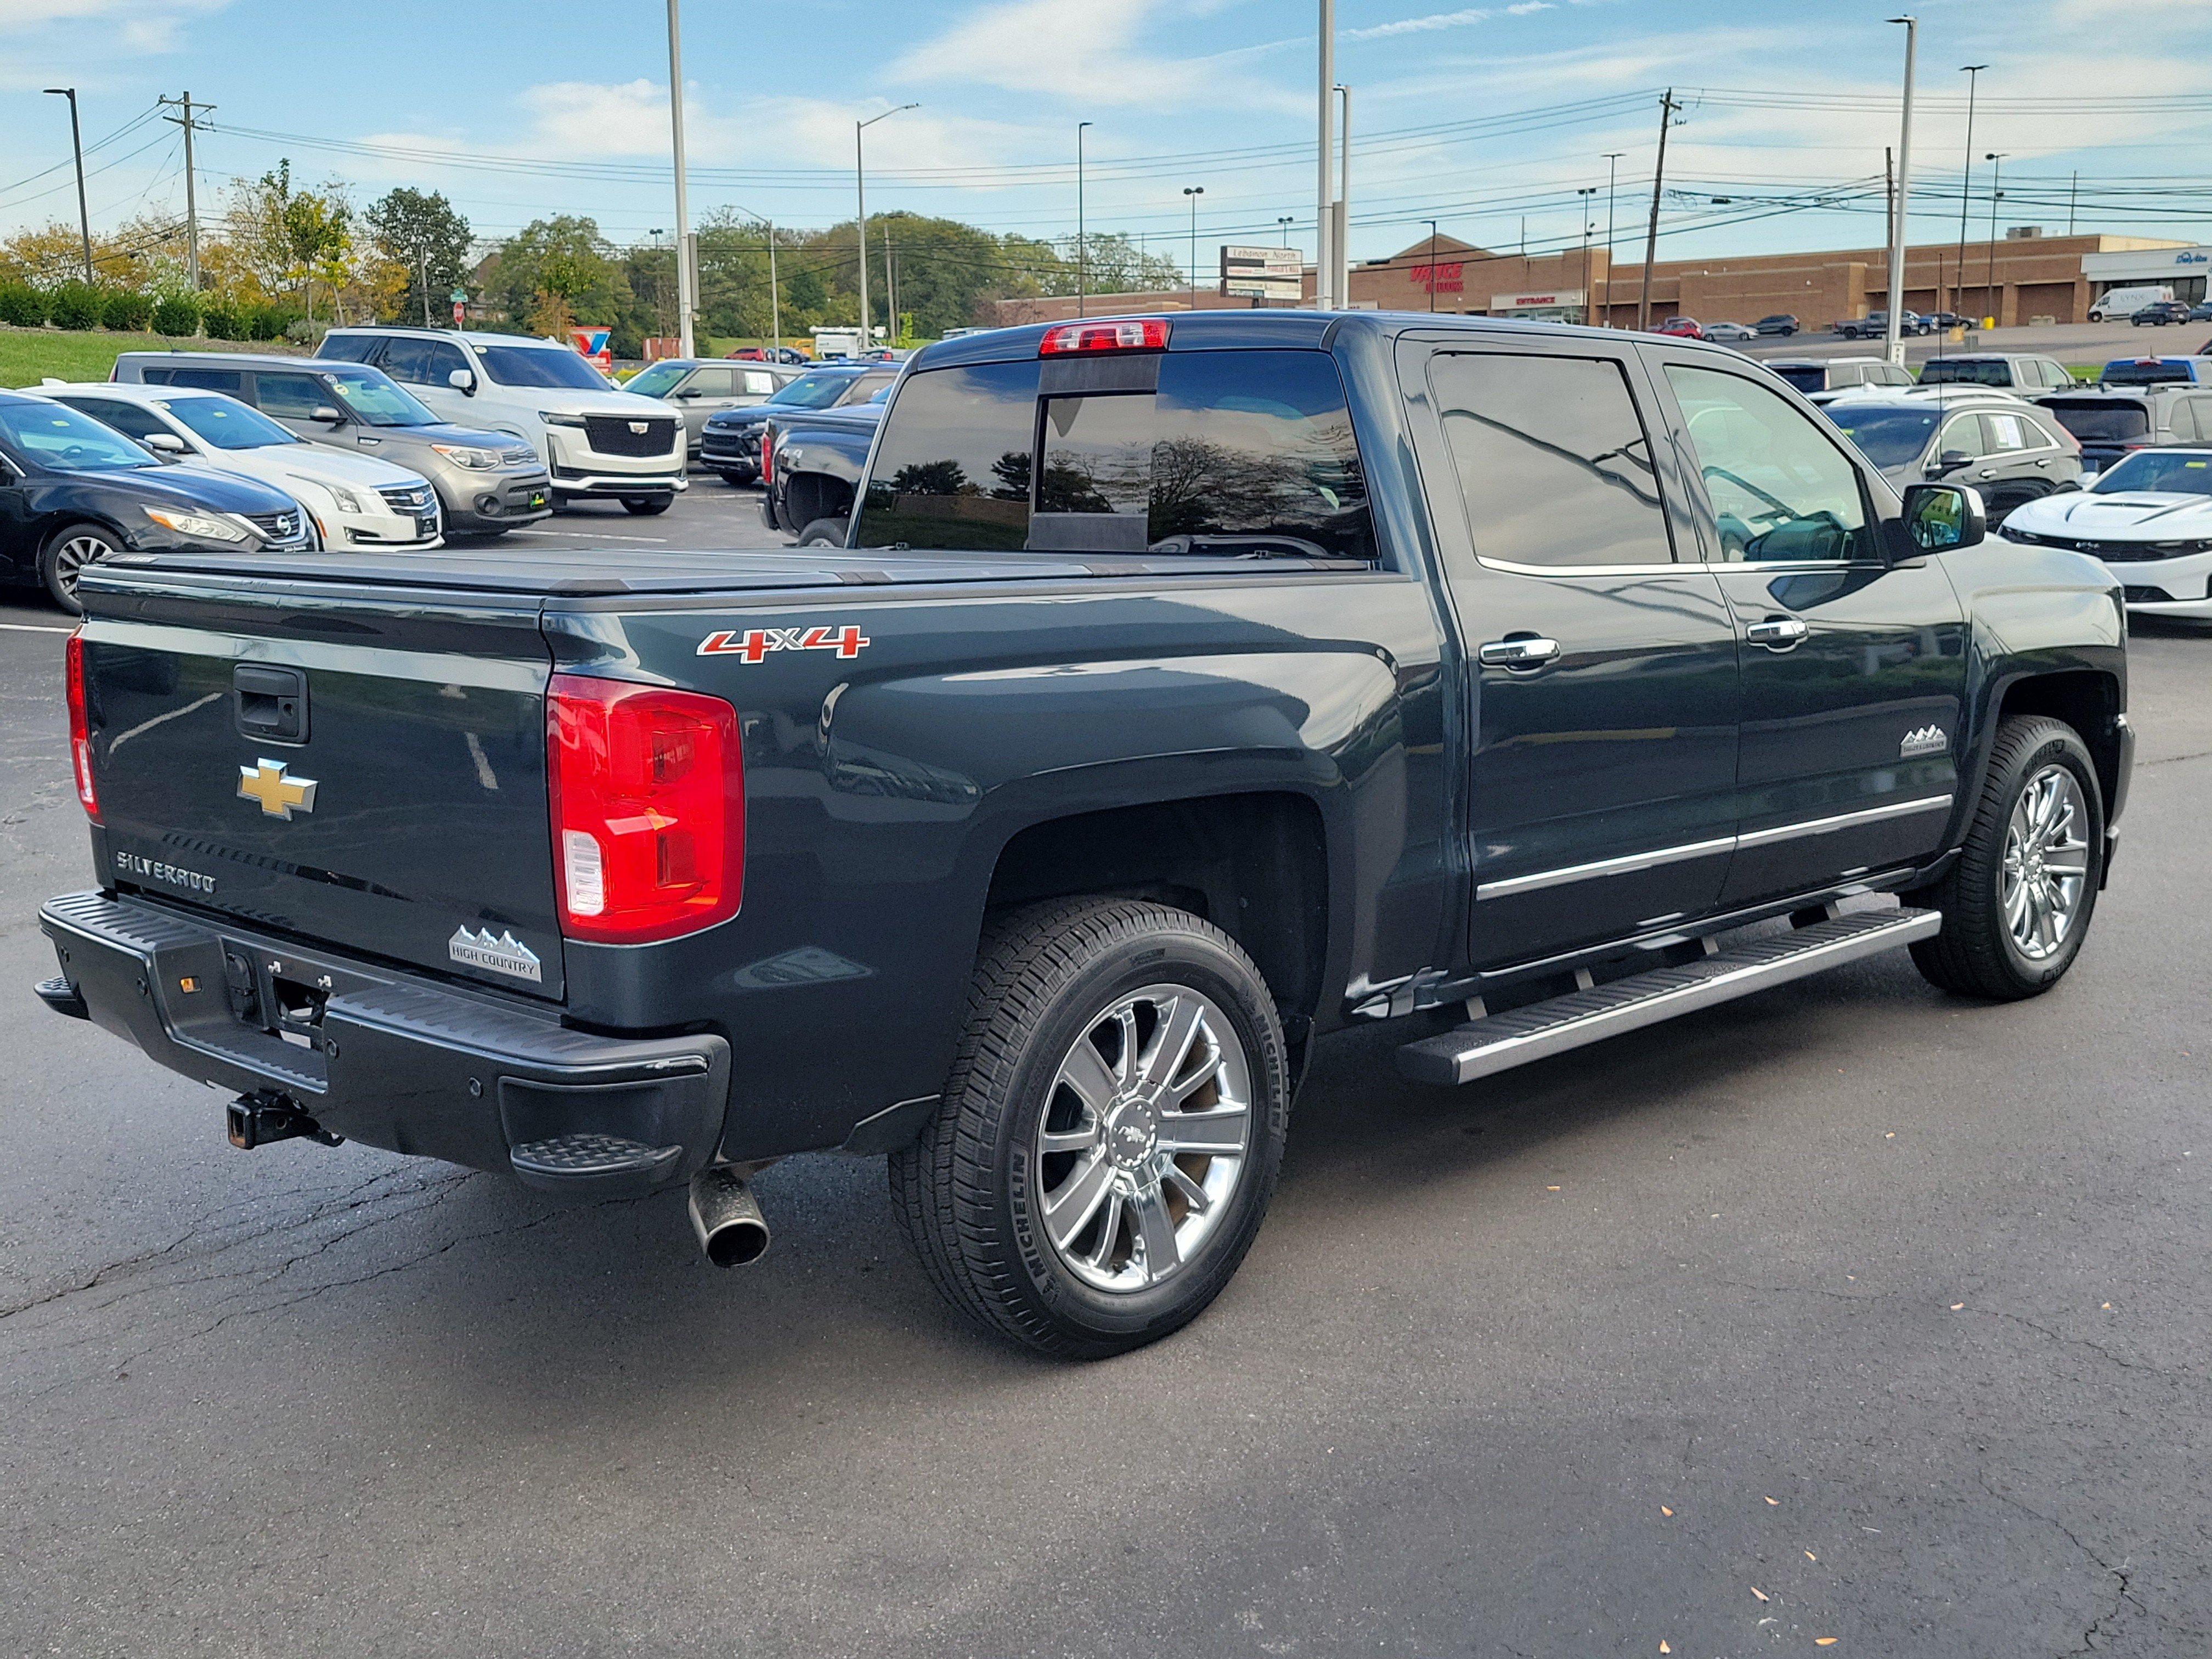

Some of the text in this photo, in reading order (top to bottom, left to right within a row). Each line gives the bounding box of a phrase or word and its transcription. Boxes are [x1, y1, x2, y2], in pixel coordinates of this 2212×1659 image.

[1233, 249, 1296, 259] Lebanon North
[117, 851, 216, 894] SILVERADO
[453, 946, 535, 975] HIGH COUNTRY
[1255, 1013, 1282, 1128] MICHELIN
[1013, 1153, 1047, 1278] MICHELIN
